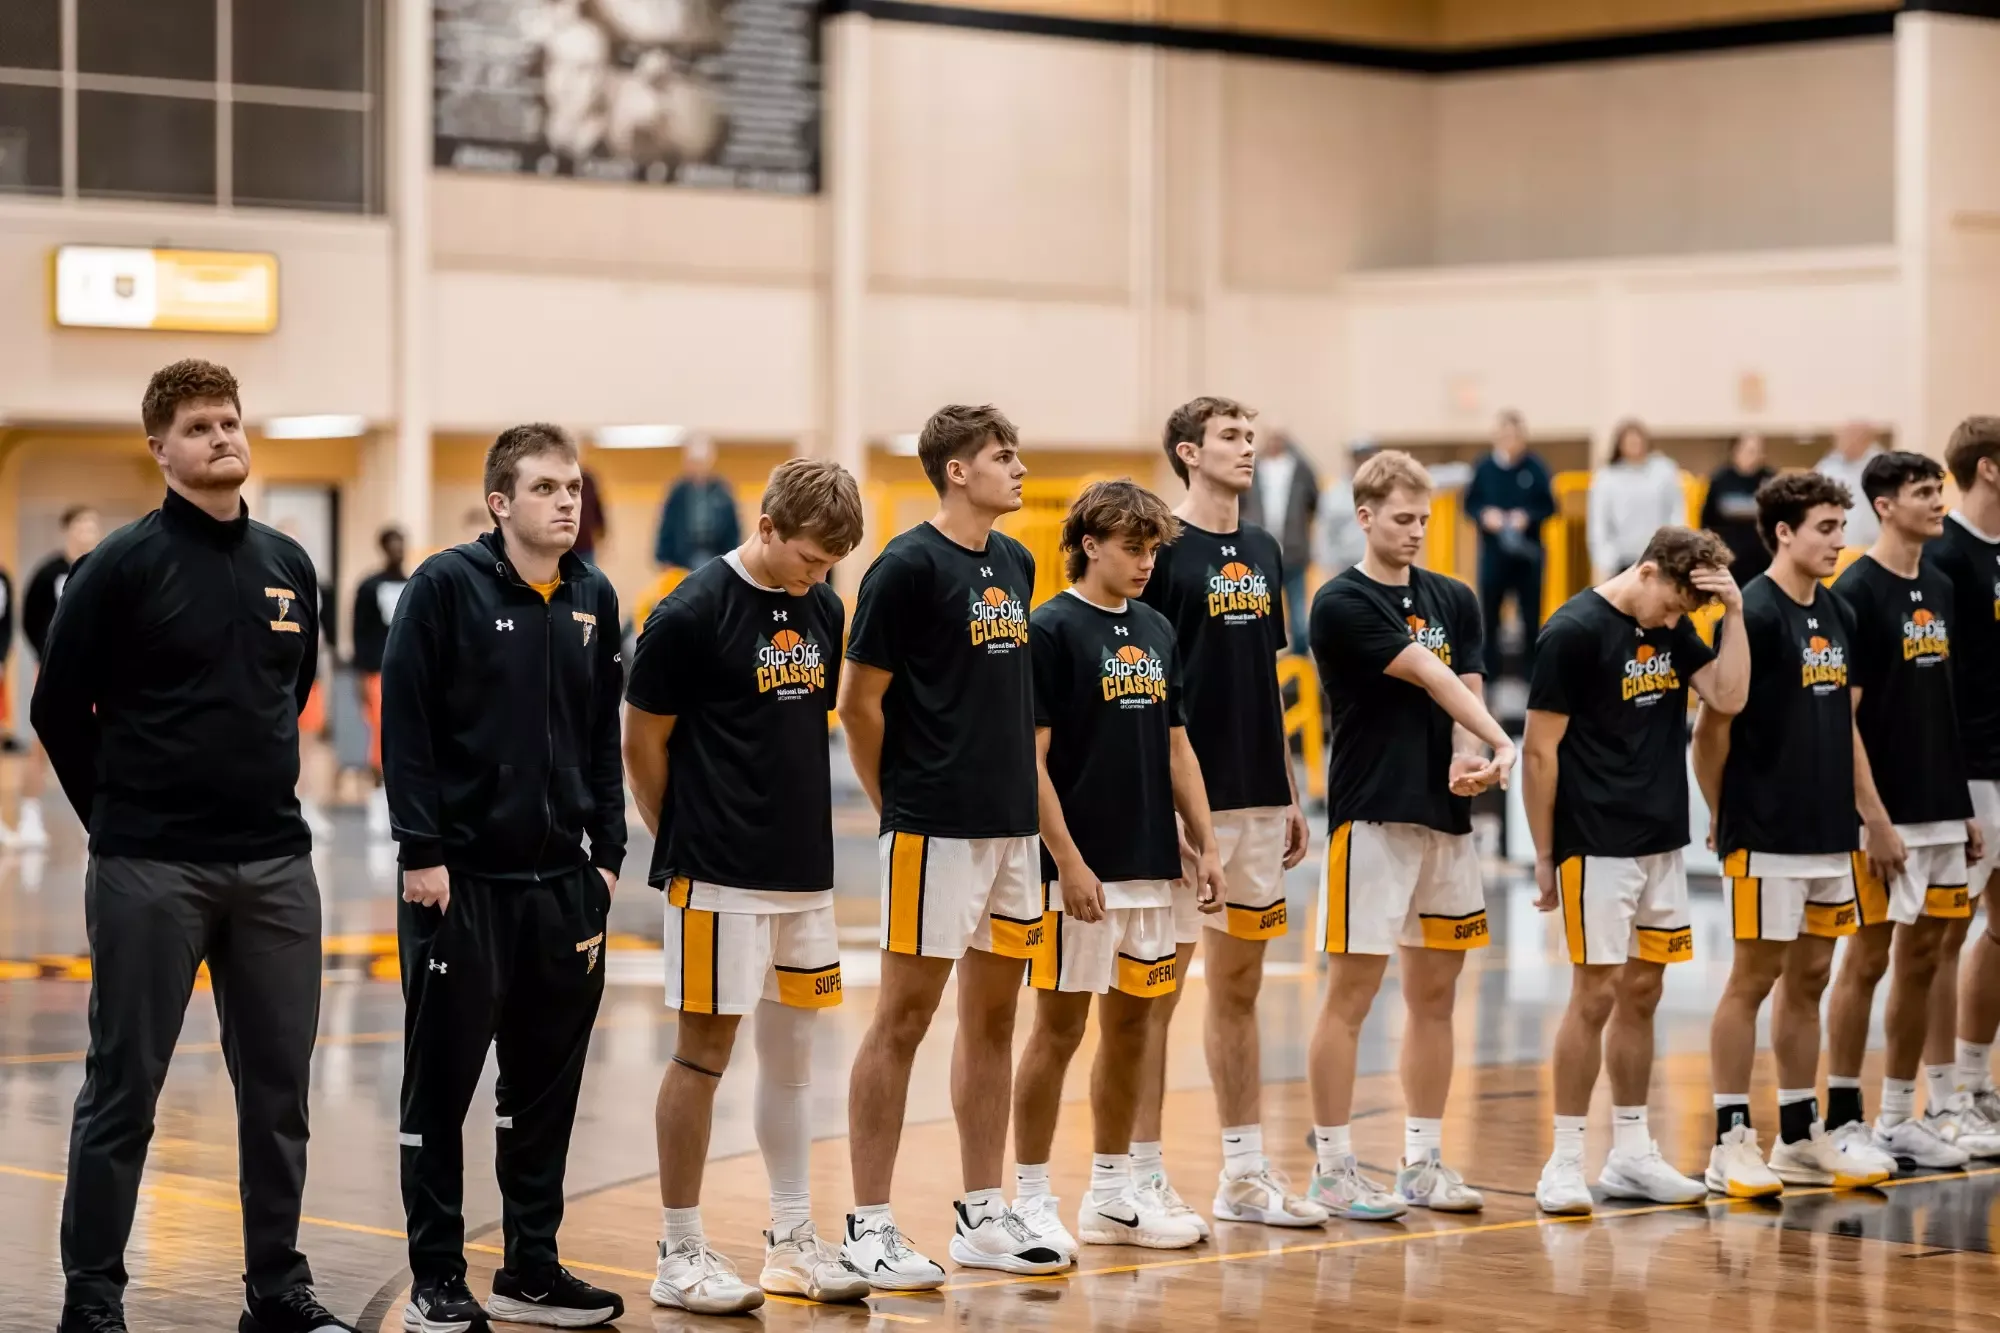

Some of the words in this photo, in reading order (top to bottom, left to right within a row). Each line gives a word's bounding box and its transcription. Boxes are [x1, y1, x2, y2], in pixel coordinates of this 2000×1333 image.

[1210, 575, 1267, 597] Tip-Off
[972, 600, 1024, 625] Tip-Off
[1208, 591, 1271, 617] CLASSIC
[970, 618, 1028, 646] CLASSIC
[759, 643, 821, 670] Tip-Off
[1104, 658, 1163, 681] Tip-Off
[757, 662, 825, 693] CLASSIC
[1101, 675, 1167, 702] CLASSIC
